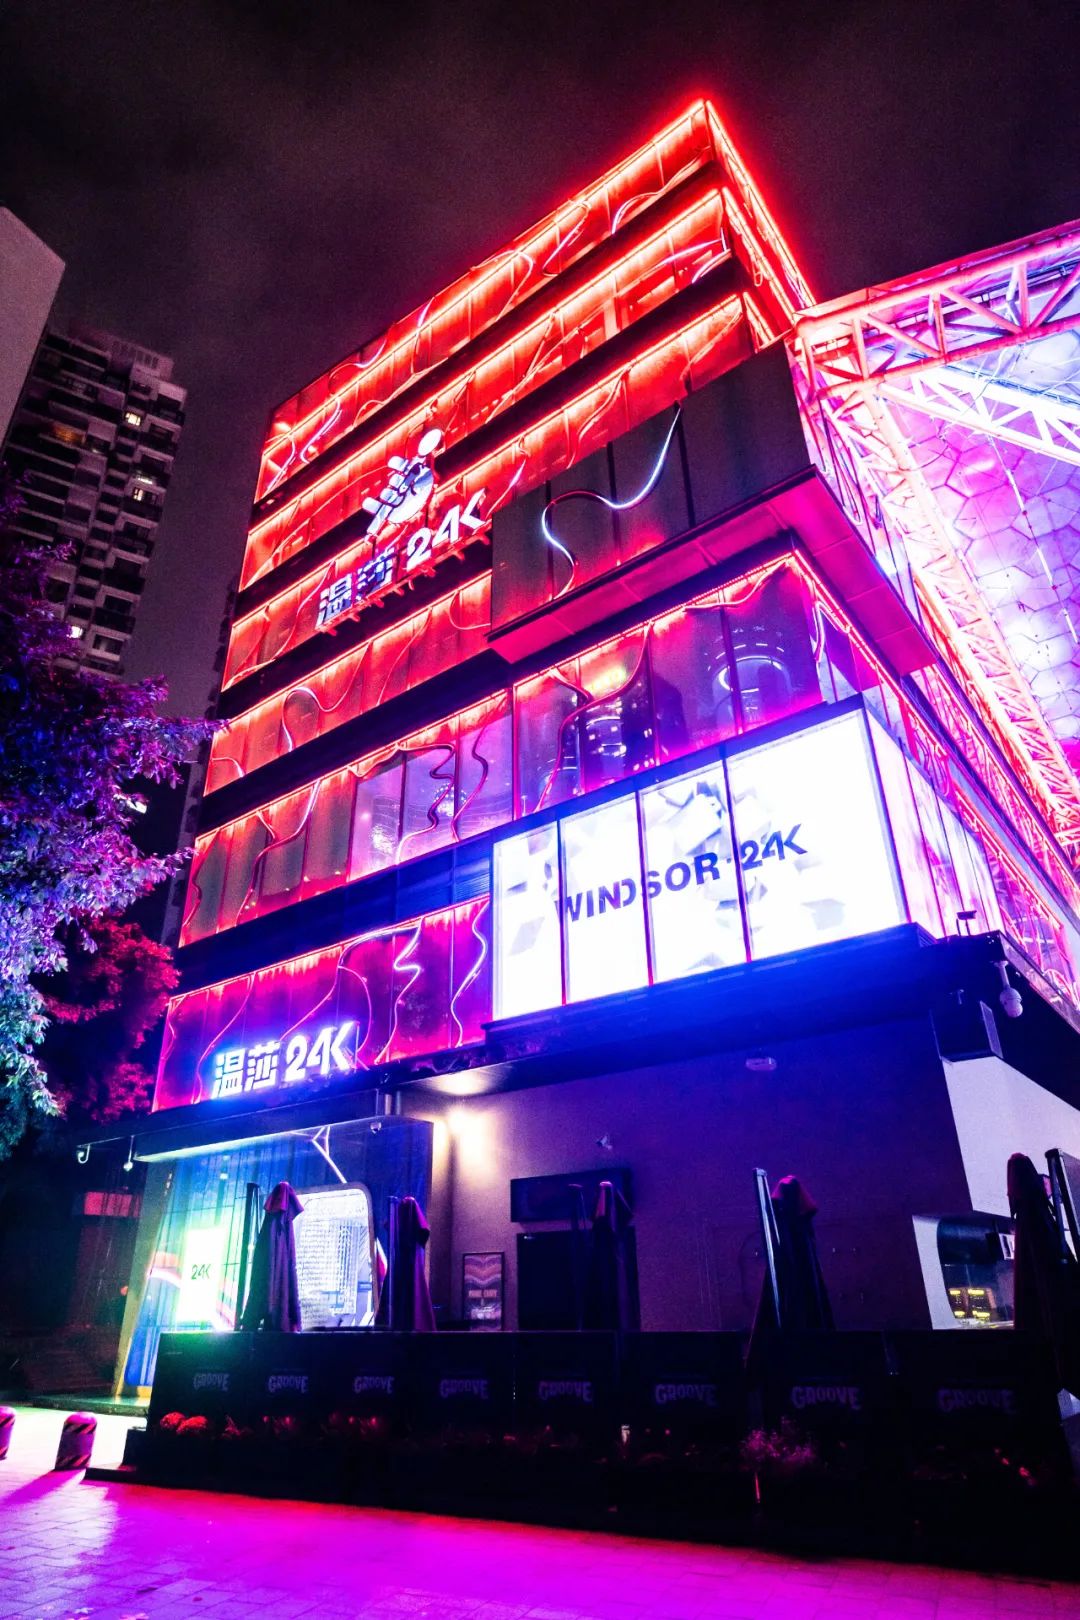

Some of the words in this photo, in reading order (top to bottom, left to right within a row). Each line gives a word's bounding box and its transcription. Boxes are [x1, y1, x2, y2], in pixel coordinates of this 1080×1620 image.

[316, 548, 395, 626] 温莎
[406, 489, 486, 570] 24K
[555, 853, 720, 923] WINDSOR
[741, 825, 808, 871] 24K
[212, 1042, 280, 1099] 温莎
[285, 1022, 355, 1081] 24K
[190, 1263, 211, 1281] 24K
[193, 1371, 230, 1393] GROOVE
[268, 1374, 309, 1395] GROOVE
[353, 1374, 396, 1396] GROOVE
[438, 1378, 490, 1401] GROOVE
[538, 1379, 592, 1403] GROOVE
[655, 1382, 719, 1408] GROOVE
[791, 1384, 863, 1411] GROOVE
